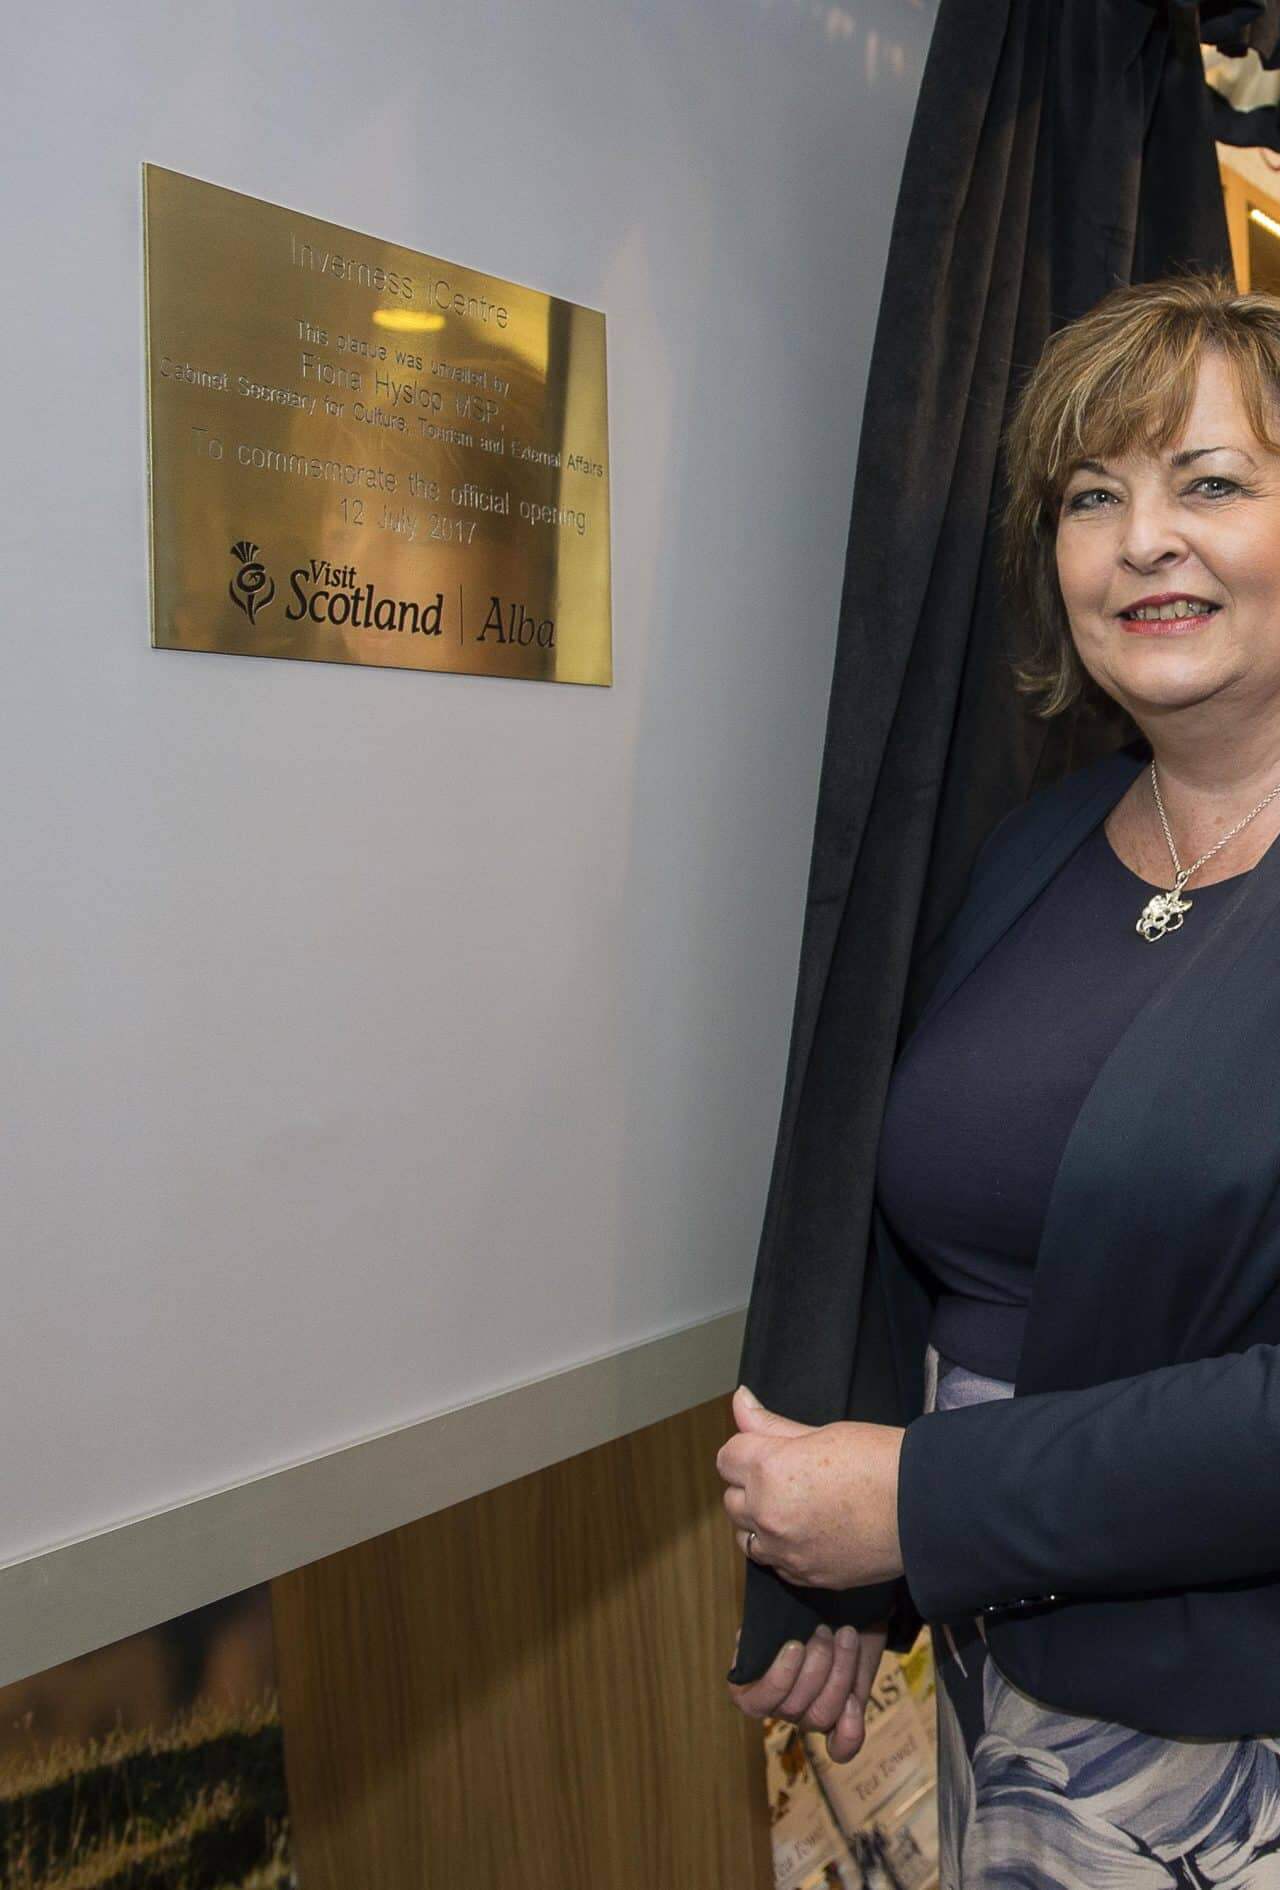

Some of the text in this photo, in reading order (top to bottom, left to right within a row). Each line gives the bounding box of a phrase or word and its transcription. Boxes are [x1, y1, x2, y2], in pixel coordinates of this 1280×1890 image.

[289, 231, 510, 329] Inverness iCentre
[296, 319, 511, 400] This plaque was unveiled by
[302, 352, 362, 391] Fiona
[374, 368, 443, 414] Hyslop
[160, 356, 229, 391] Cabinet
[238, 375, 317, 416] Secretary
[325, 395, 345, 417] for
[418, 416, 473, 448] Tourism
[480, 435, 504, 456] and
[511, 440, 560, 468] External
[567, 453, 603, 478] Affairs
[192, 426, 586, 536] To commemorate the official opening
[340, 498, 477, 545] 12 July 2017
[285, 569, 555, 649] Scotland Alba
[309, 559, 357, 589] Visit
